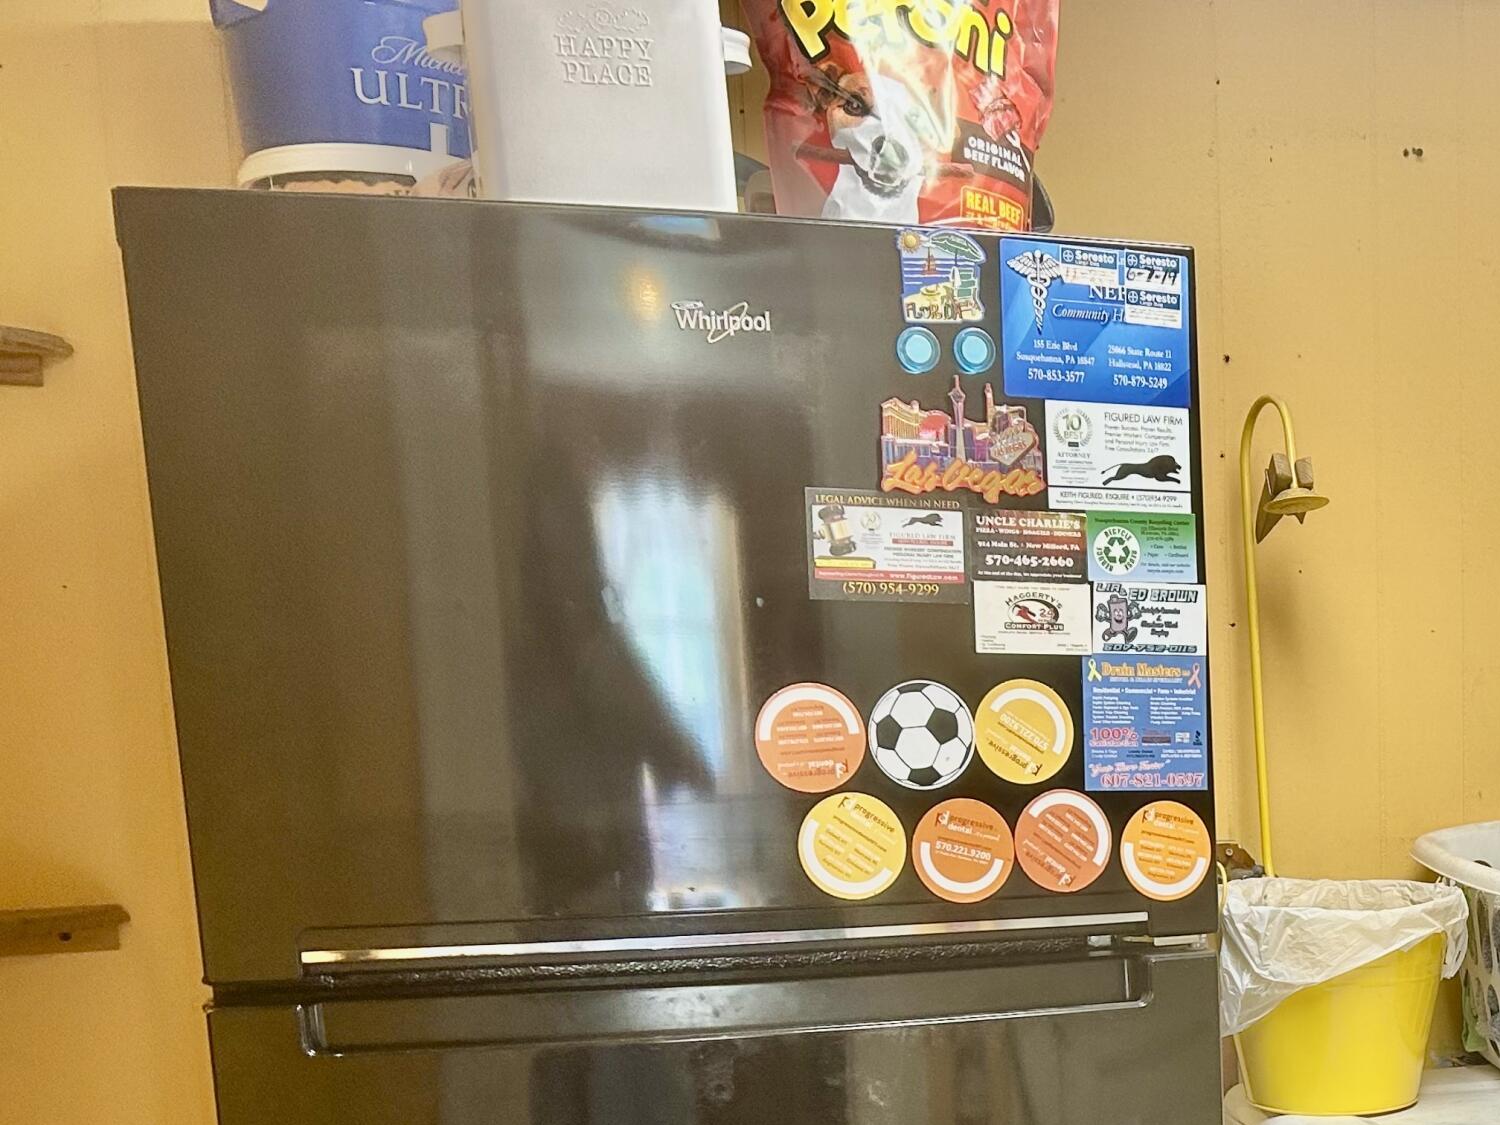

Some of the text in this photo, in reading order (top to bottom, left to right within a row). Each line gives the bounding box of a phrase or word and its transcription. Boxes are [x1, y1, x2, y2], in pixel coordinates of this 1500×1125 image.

[554, 34, 654, 60] HAPPY
[561, 60, 653, 87] PLACE
[968, 136, 1022, 167] ORIGINAL
[964, 147, 1025, 182] BEEF FLAVOR
[966, 190, 1021, 225] REAL BEEF
[1075, 250, 1115, 264] Seresto
[1139, 254, 1177, 268] Seresto
[1139, 290, 1178, 304] Seresto
[1053, 304, 1109, 325] Community
[674, 309, 772, 337] Whirlpool
[1062, 342, 1078, 351] Blvd
[1128, 346, 1144, 356] State
[1145, 347, 1164, 358] Route
[1065, 355, 1075, 365] PA
[1143, 361, 1152, 370] PA
[1028, 367, 1085, 384] 570-853-3577
[1062, 413, 1082, 431] 10
[1104, 412, 1183, 426] FIGURED LAW FIRM
[882, 450, 939, 494] Las
[942, 458, 1046, 504] Vegas
[815, 494, 960, 509] LEGAL ADVICE WHEN IN NEED
[976, 515, 1080, 530] UNCLE CHARLIE'S
[985, 554, 1075, 568] 570-465-2660
[843, 582, 940, 596] (570) 954-9299
[1128, 588, 1149, 602] ED
[1150, 588, 1199, 604] BROWN
[1005, 623, 1064, 631] COMFORT PLUS
[1101, 662, 1135, 677] Drain
[1136, 662, 1182, 678] Masters
[1090, 727, 1138, 741] 100%
[854, 803, 895, 833] progressive
[950, 815, 994, 830] progressive
[1155, 812, 1194, 825] progressive
[948, 823, 974, 835] dental
[935, 841, 992, 861] 570.221.9200
